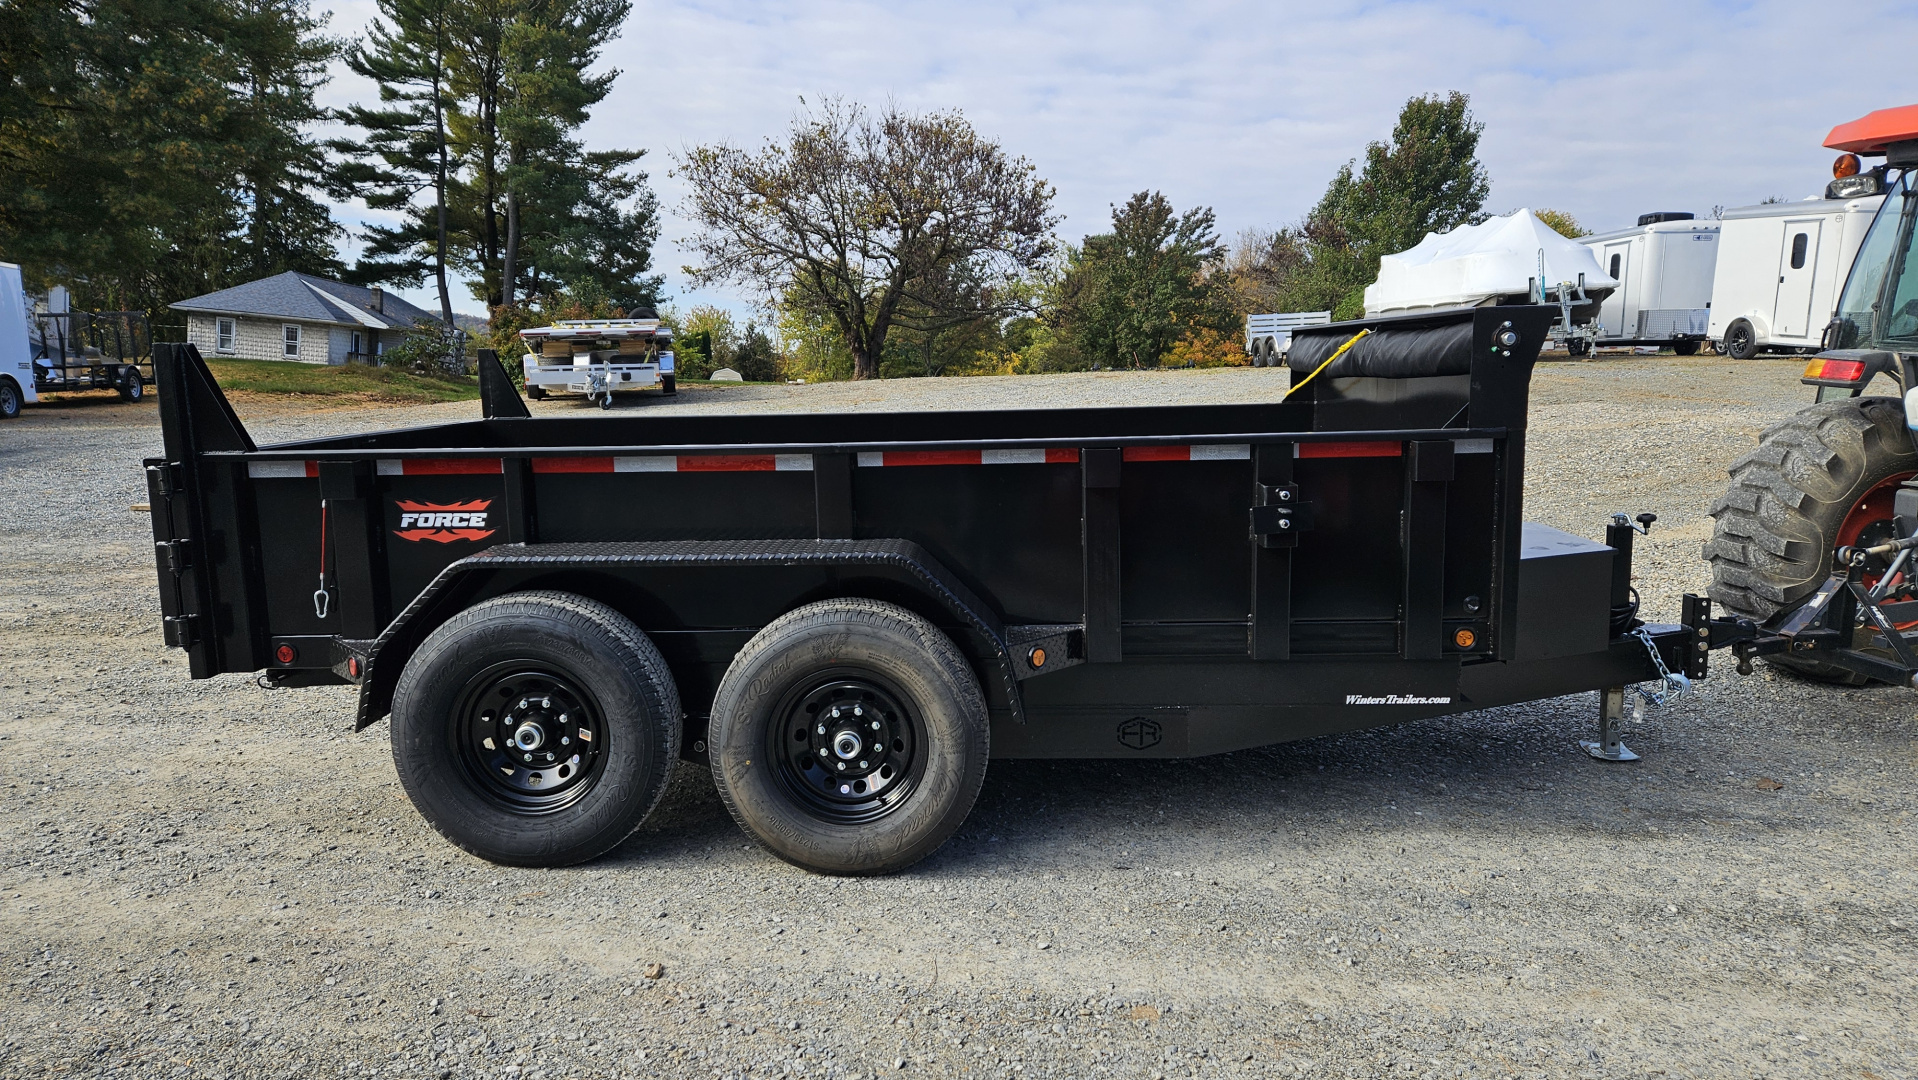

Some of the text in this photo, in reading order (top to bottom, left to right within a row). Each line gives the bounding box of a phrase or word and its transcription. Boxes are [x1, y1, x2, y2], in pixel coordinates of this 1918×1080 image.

[400, 512, 488, 528] FORCE
[748, 652, 793, 701] Radial
[1345, 694, 1451, 705] WintersTrailers.com
[767, 815, 821, 851] ST235/80R16
